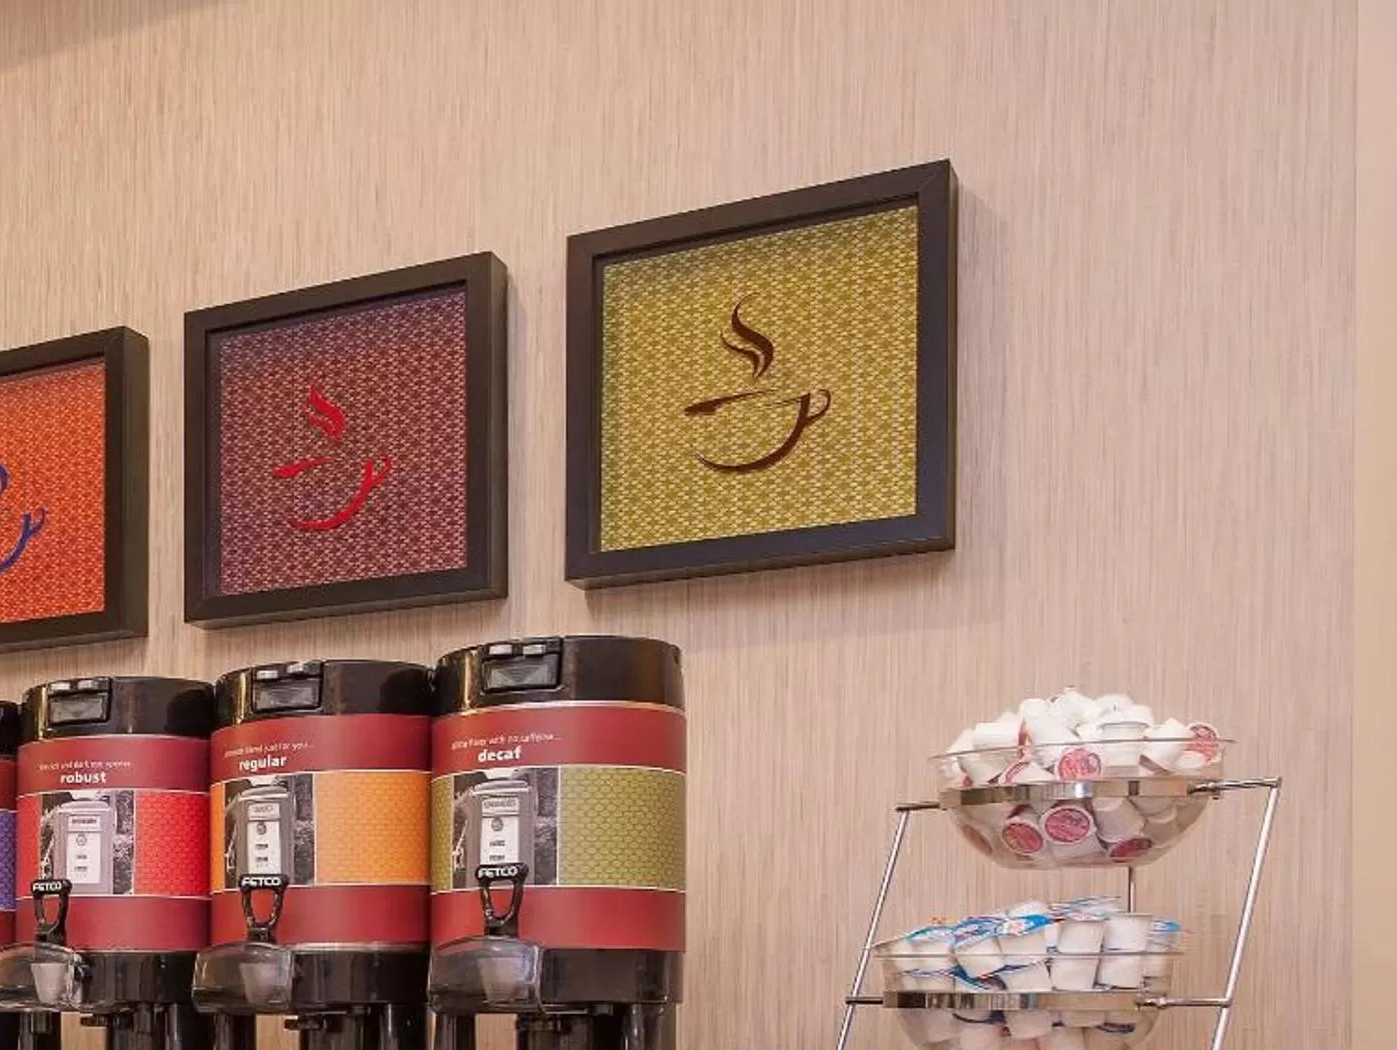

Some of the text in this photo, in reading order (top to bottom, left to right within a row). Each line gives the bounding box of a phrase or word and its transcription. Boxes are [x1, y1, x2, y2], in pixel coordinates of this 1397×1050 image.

[478, 745, 522, 762] decaf
[238, 754, 288, 773] regular
[60, 771, 107, 784] robust
